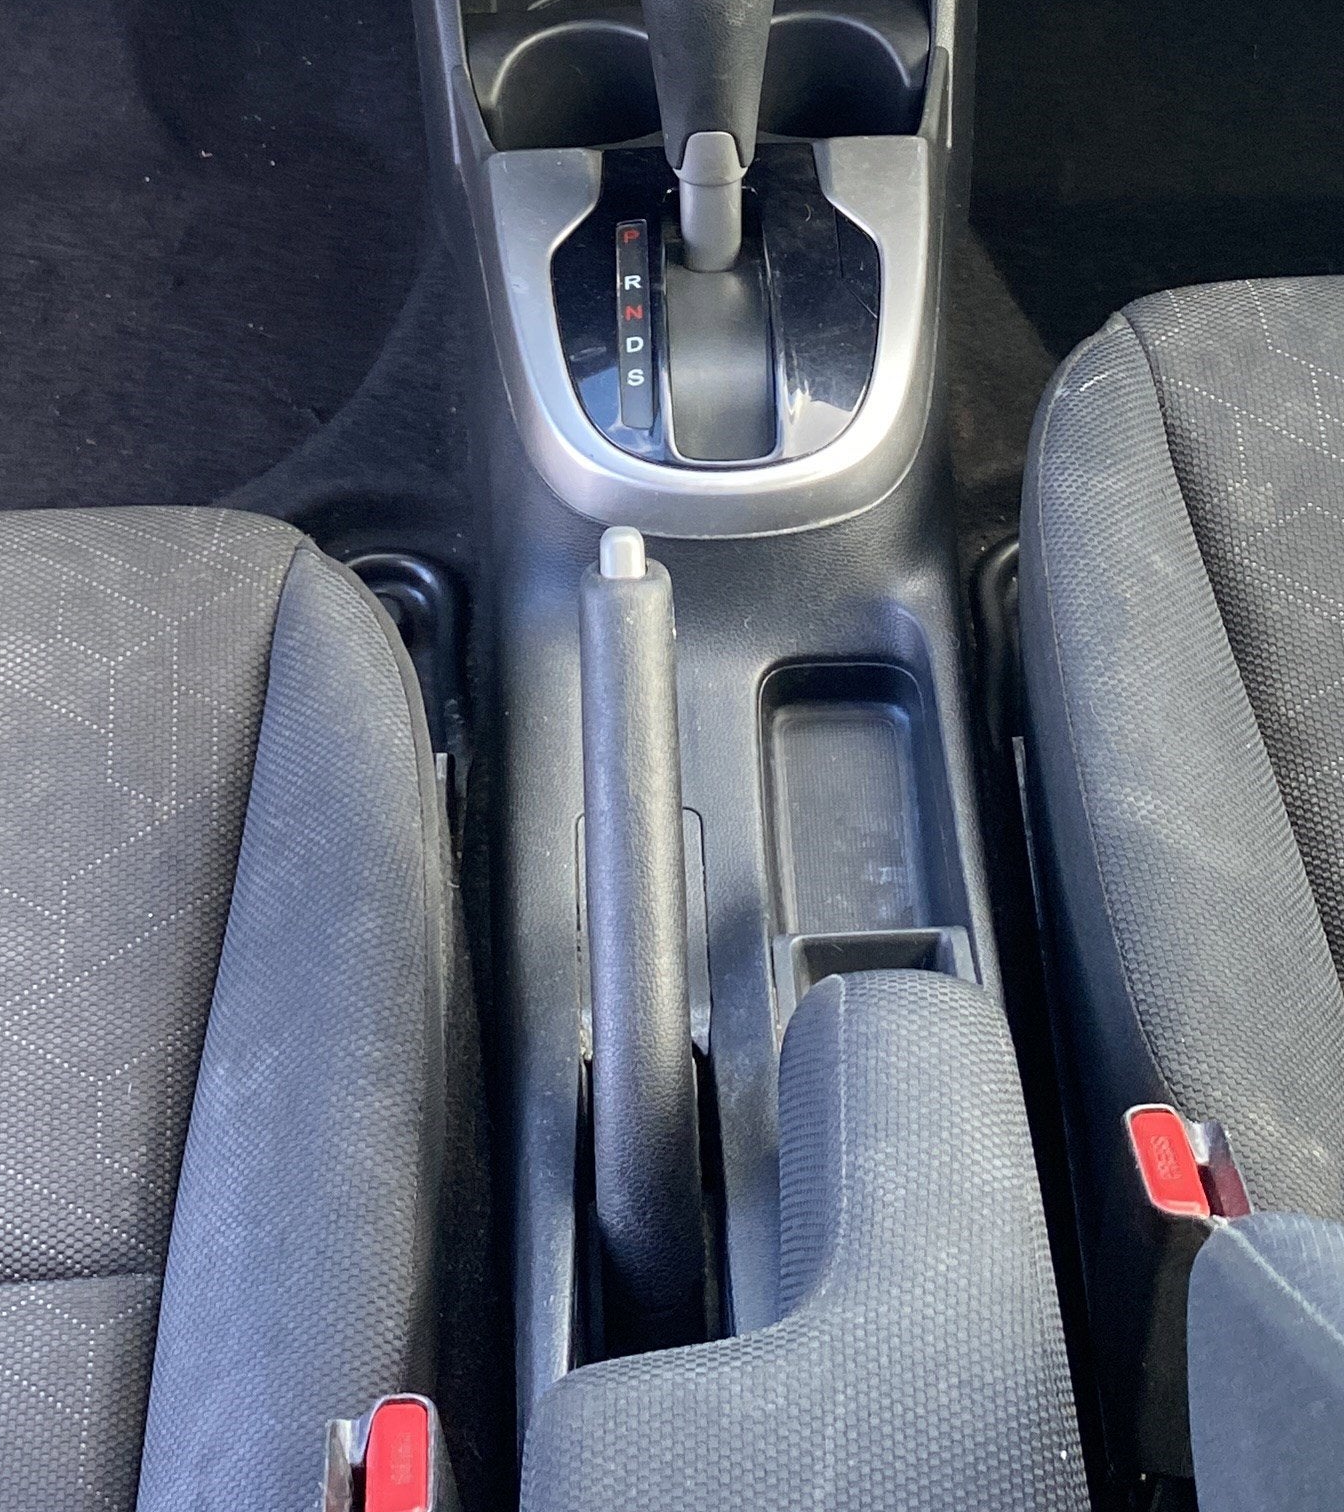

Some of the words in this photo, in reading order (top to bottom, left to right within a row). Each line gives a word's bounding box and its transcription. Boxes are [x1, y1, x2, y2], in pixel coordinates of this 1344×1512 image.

[623, 228, 641, 244] P
[624, 274, 642, 290] R
[624, 305, 644, 321] N
[626, 336, 644, 353] D
[627, 369, 645, 387] S
